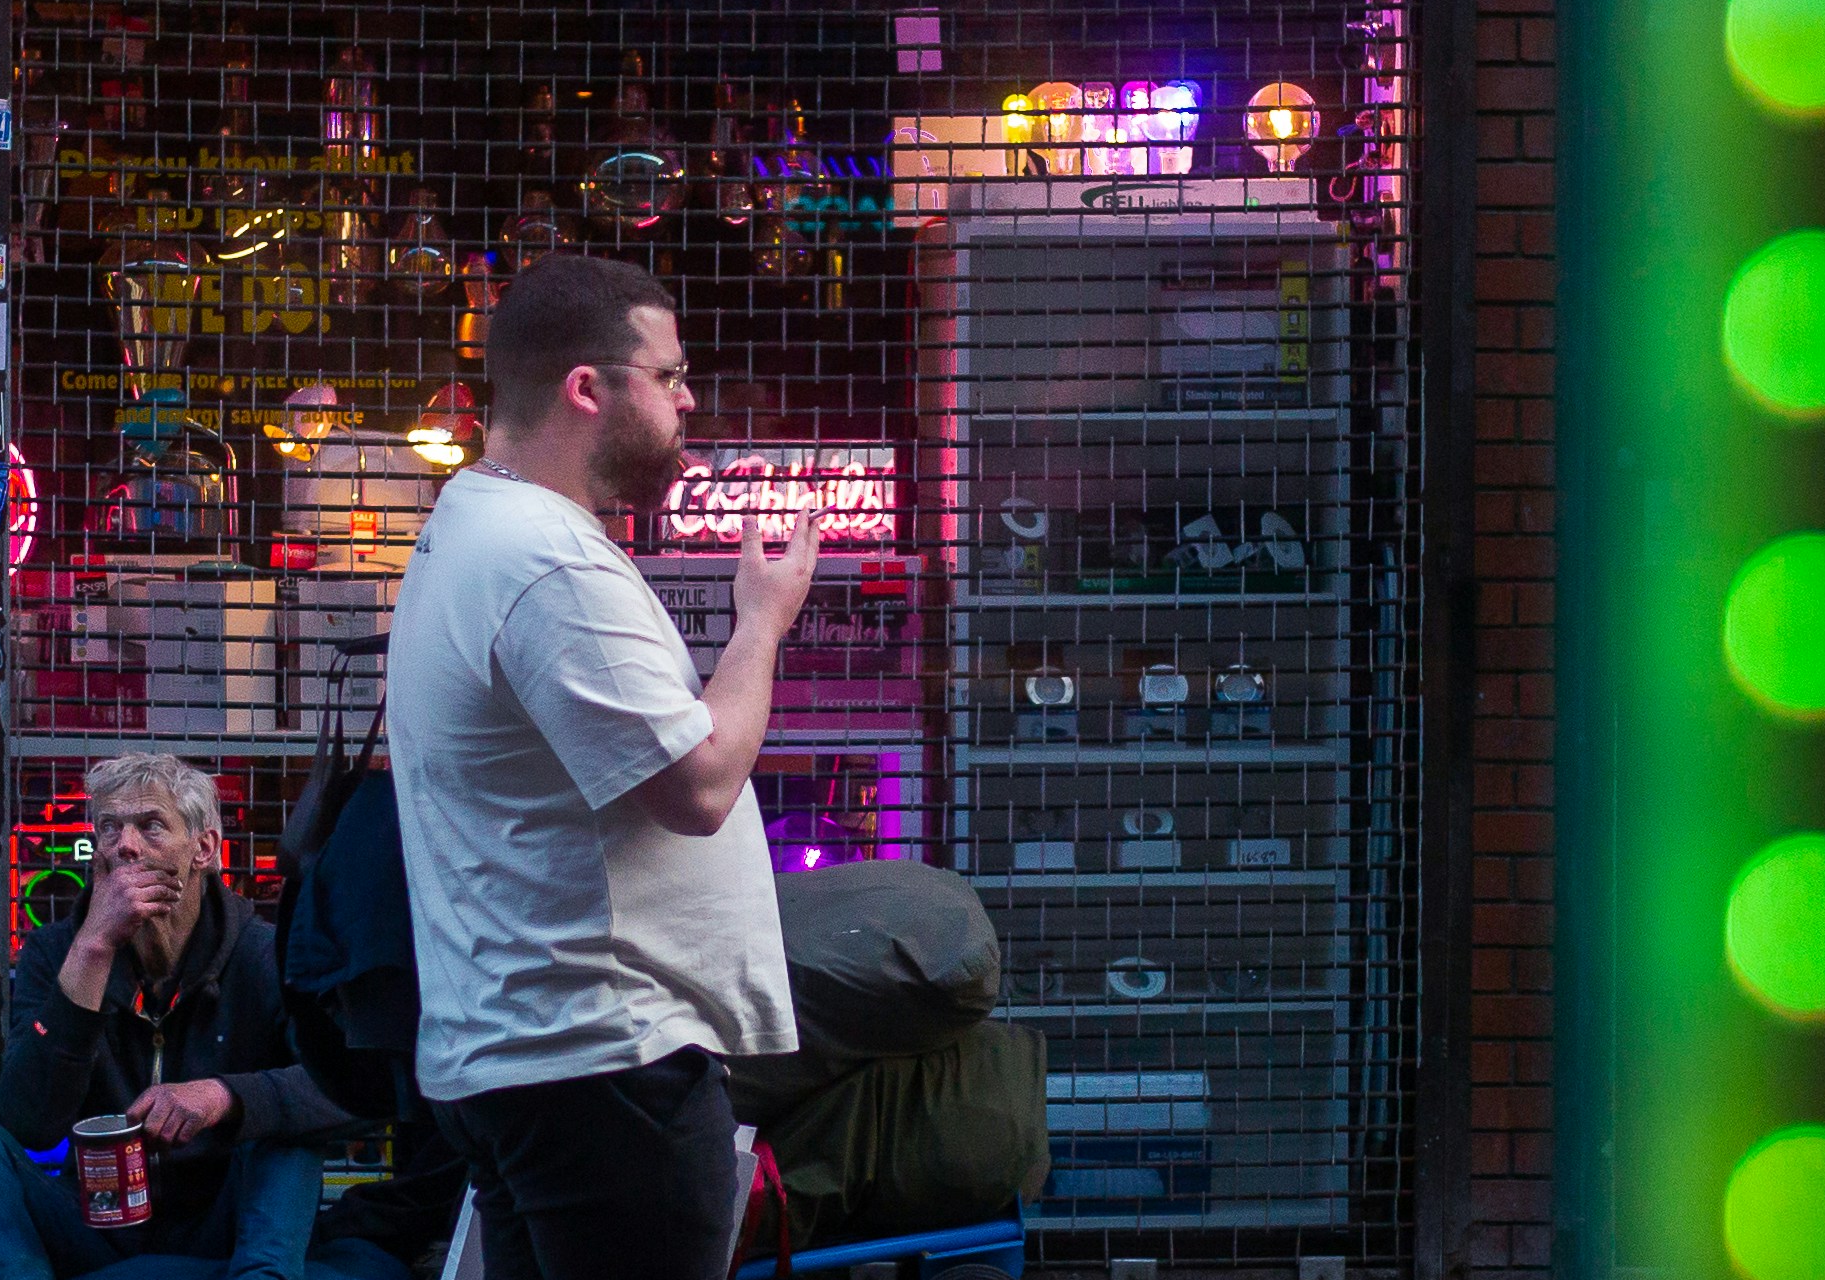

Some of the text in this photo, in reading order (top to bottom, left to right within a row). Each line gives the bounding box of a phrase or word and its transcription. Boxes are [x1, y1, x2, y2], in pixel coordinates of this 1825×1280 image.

[146, 263, 332, 335] WE DO!
[61, 371, 118, 390] Come
